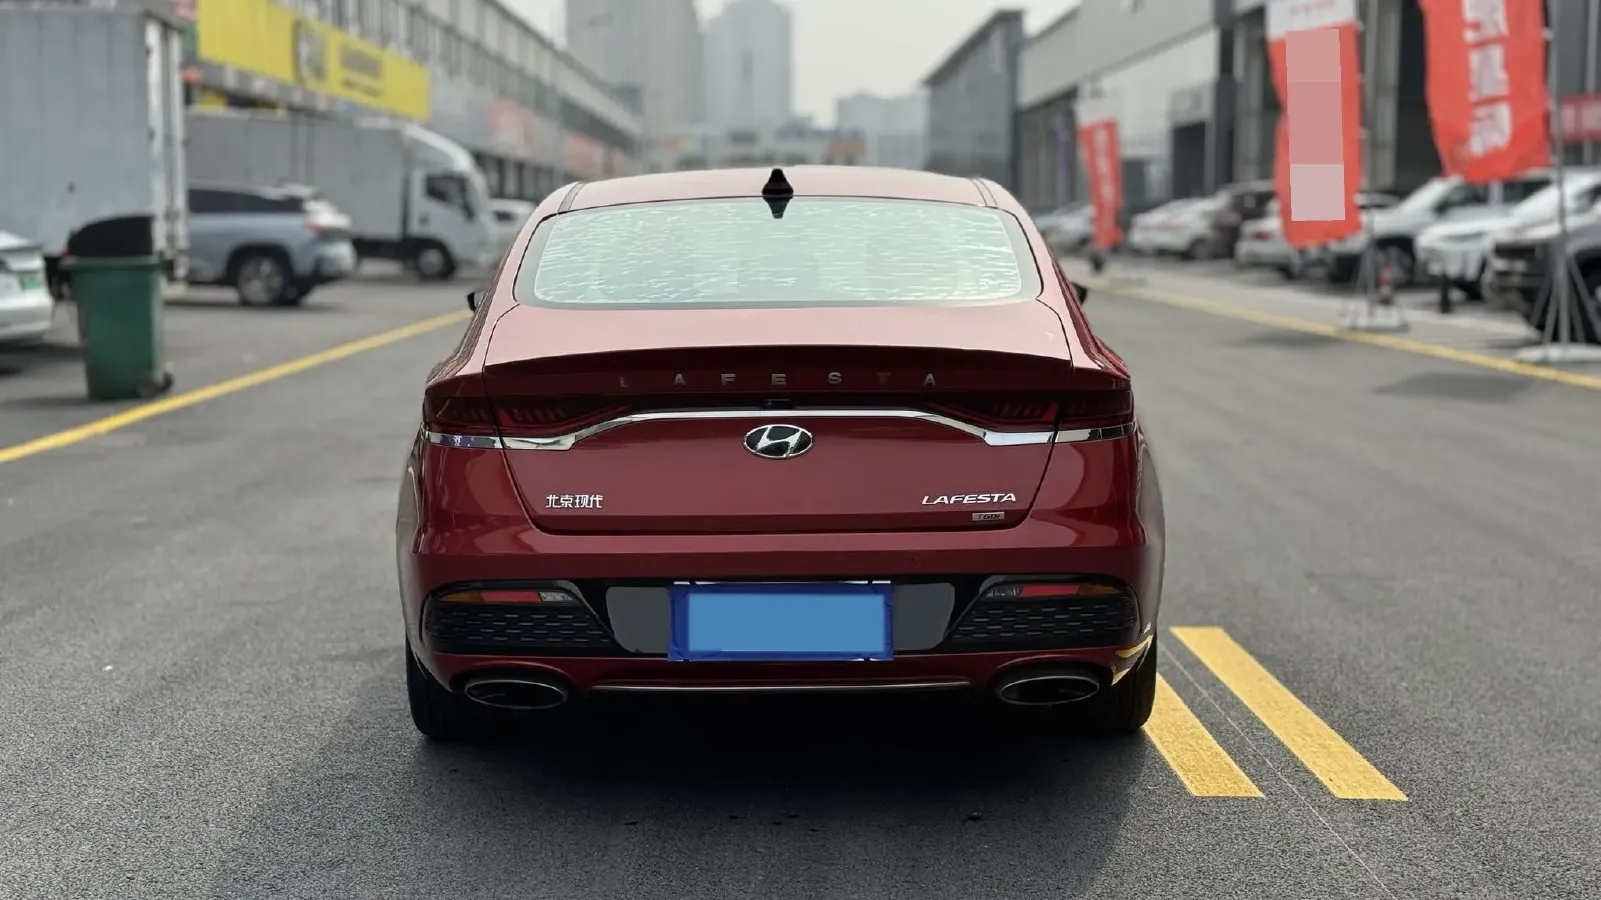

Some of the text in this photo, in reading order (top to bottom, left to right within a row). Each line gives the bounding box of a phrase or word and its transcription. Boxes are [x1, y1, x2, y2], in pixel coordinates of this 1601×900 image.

[619, 372, 937, 388] LAFESTA
[545, 494, 604, 509] 北京现代
[921, 493, 1017, 505] LAFESTA
